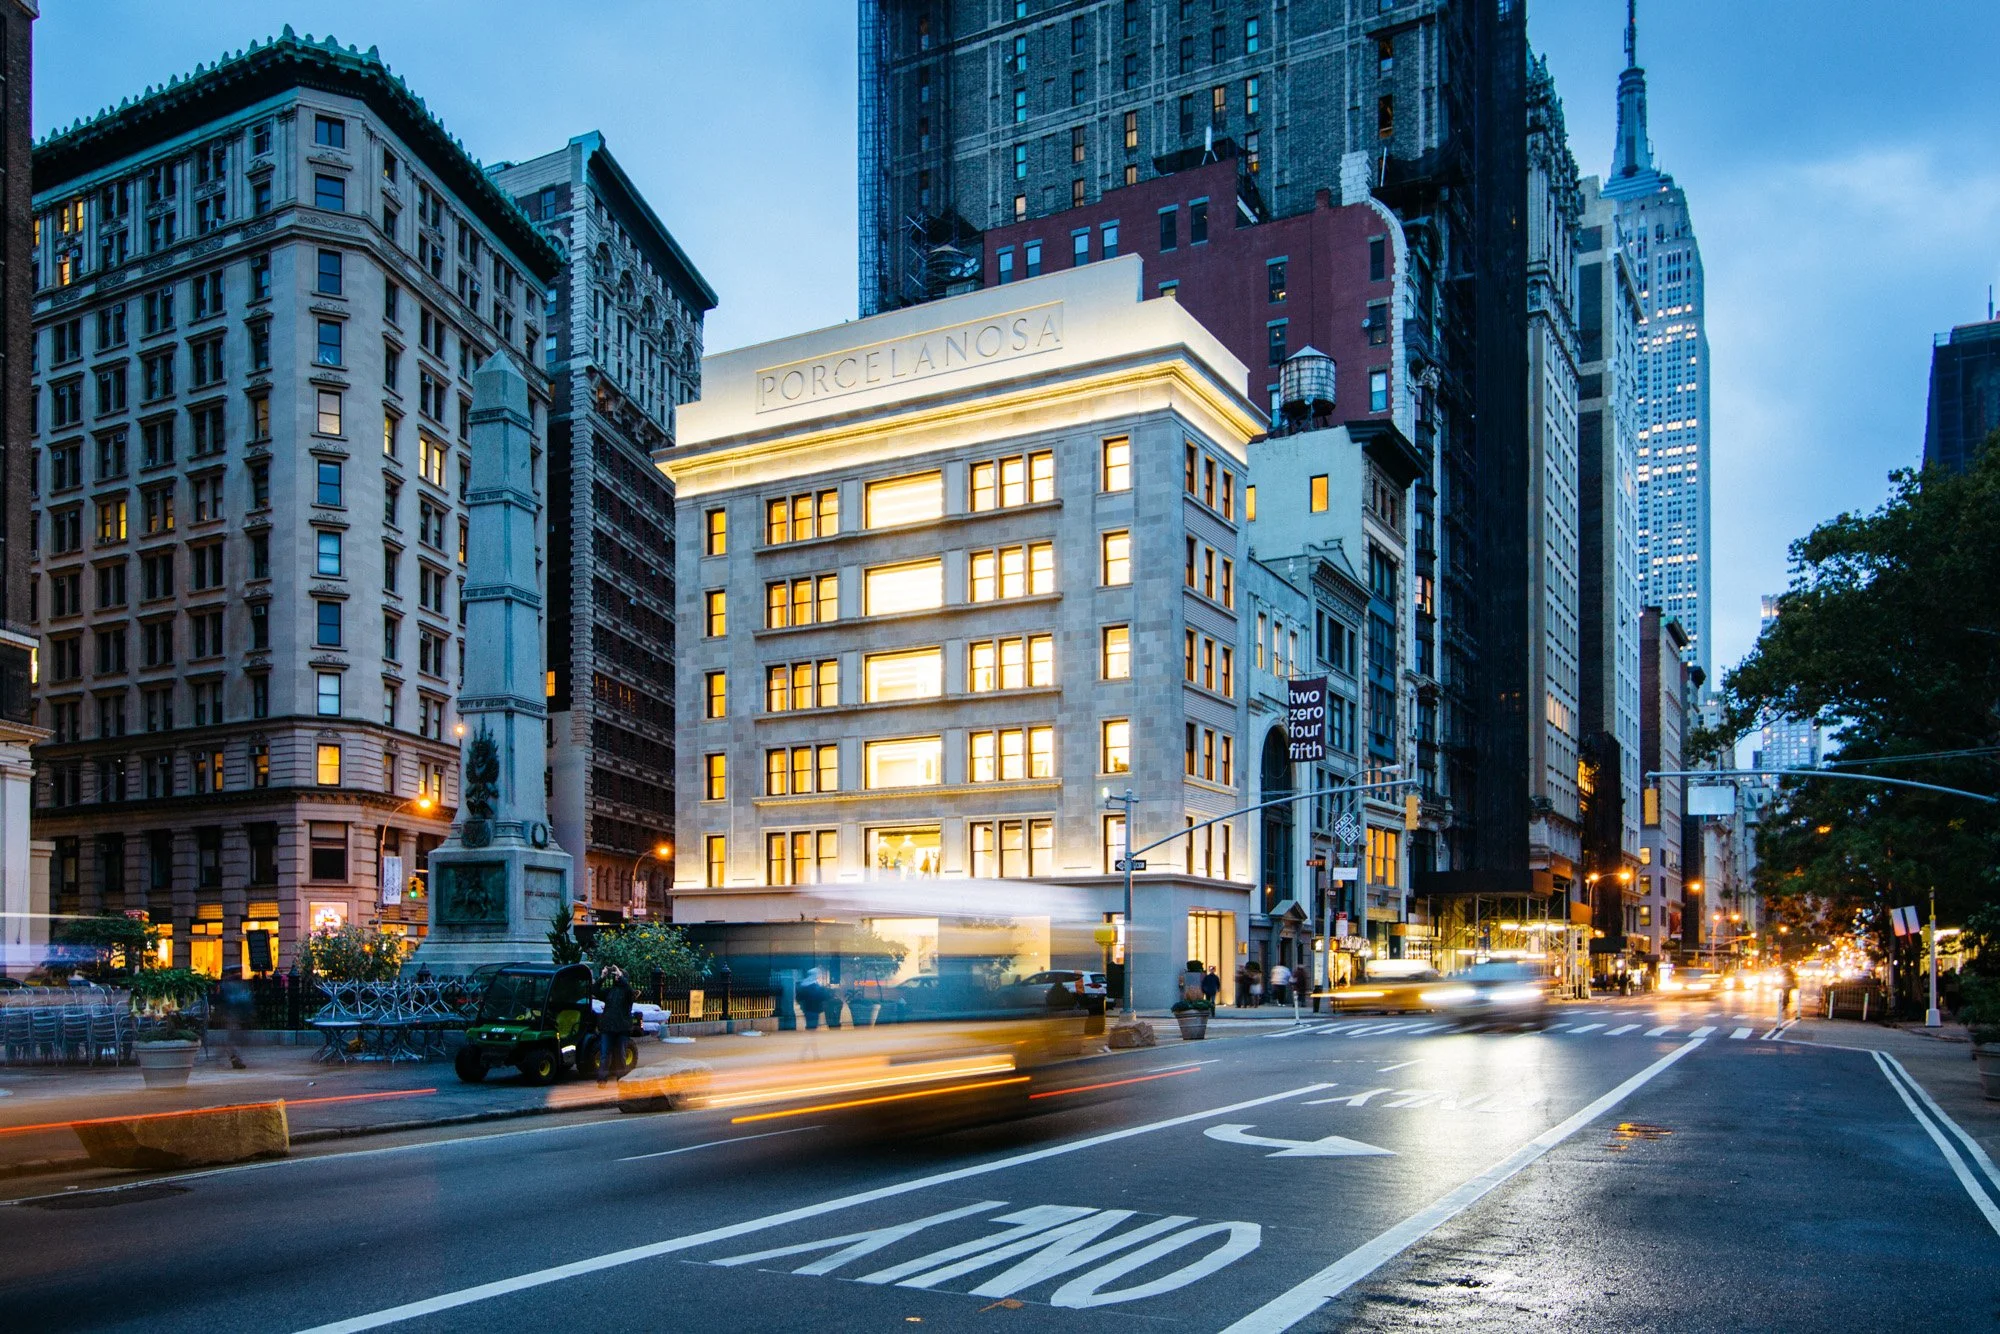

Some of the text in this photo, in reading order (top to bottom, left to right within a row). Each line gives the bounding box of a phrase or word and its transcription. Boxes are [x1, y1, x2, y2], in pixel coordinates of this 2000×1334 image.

[762, 314, 1060, 406] PORCELANOSA
[1289, 690, 1320, 704] two
[1289, 706, 1324, 721] zero
[1289, 722, 1322, 738] four
[1289, 741, 1323, 759] fifth
[708, 1201, 1262, 1309] ONLY
